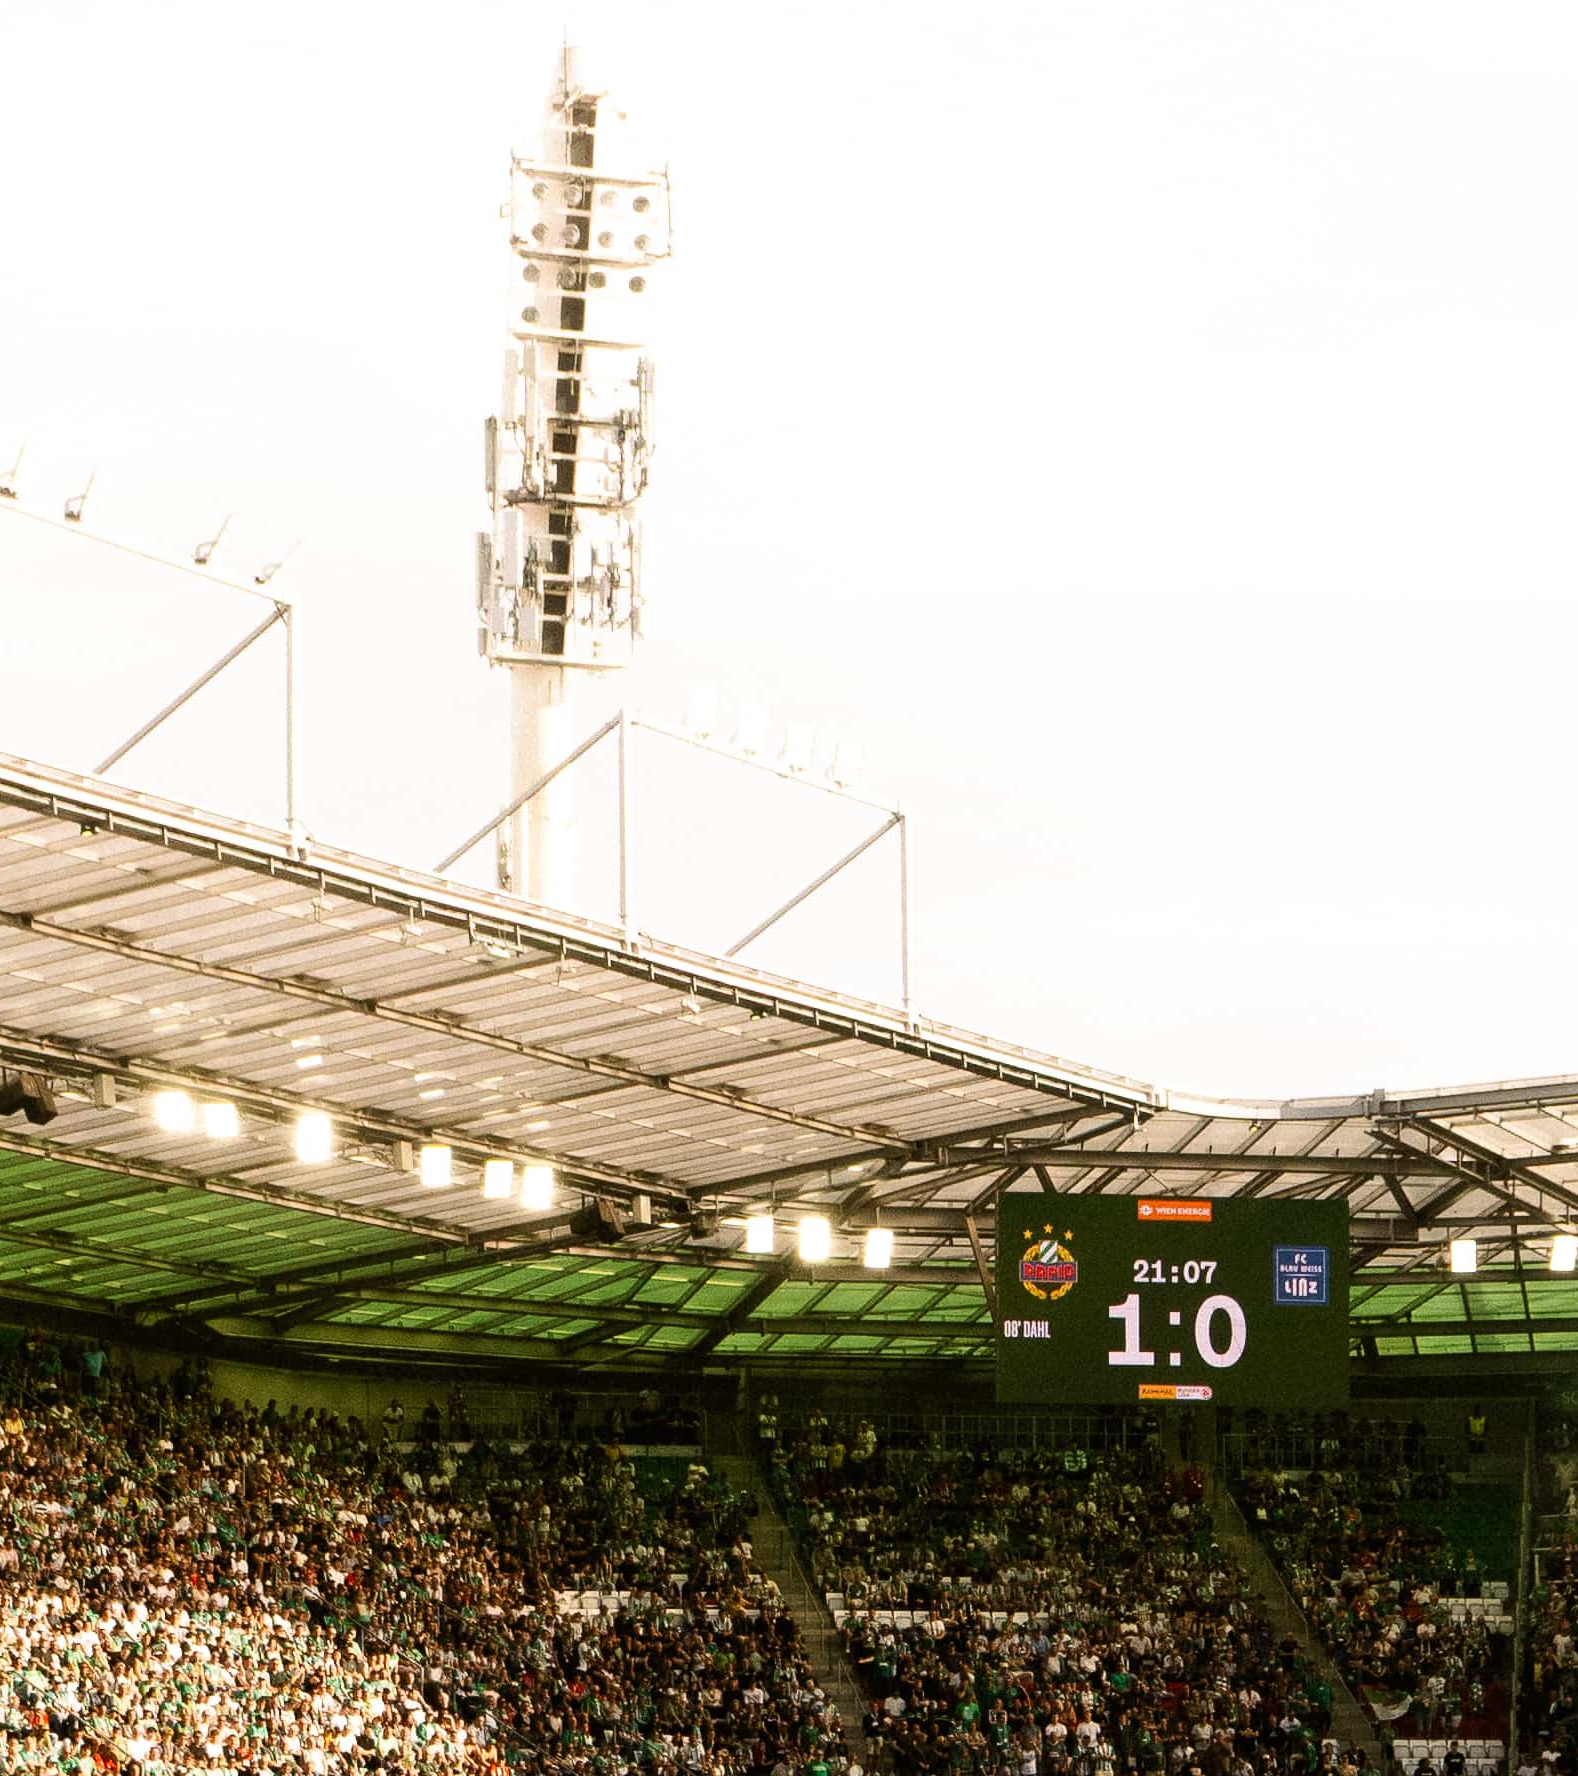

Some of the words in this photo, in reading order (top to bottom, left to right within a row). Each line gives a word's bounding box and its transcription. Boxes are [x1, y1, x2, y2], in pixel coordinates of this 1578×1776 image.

[1156, 1207, 1176, 1215] WIEN
[1295, 1253, 1307, 1265] FC
[1023, 1262, 1075, 1280] RAPID
[1133, 1259, 1217, 1283] 21:07
[1280, 1264, 1298, 1273] BLAU
[1300, 1264, 1322, 1273] WEISS
[1284, 1277, 1318, 1297] LINZ
[1004, 1319, 1022, 1338] 08'
[1023, 1320, 1051, 1338] DAHL
[1107, 1293, 1247, 1368] 1:0
